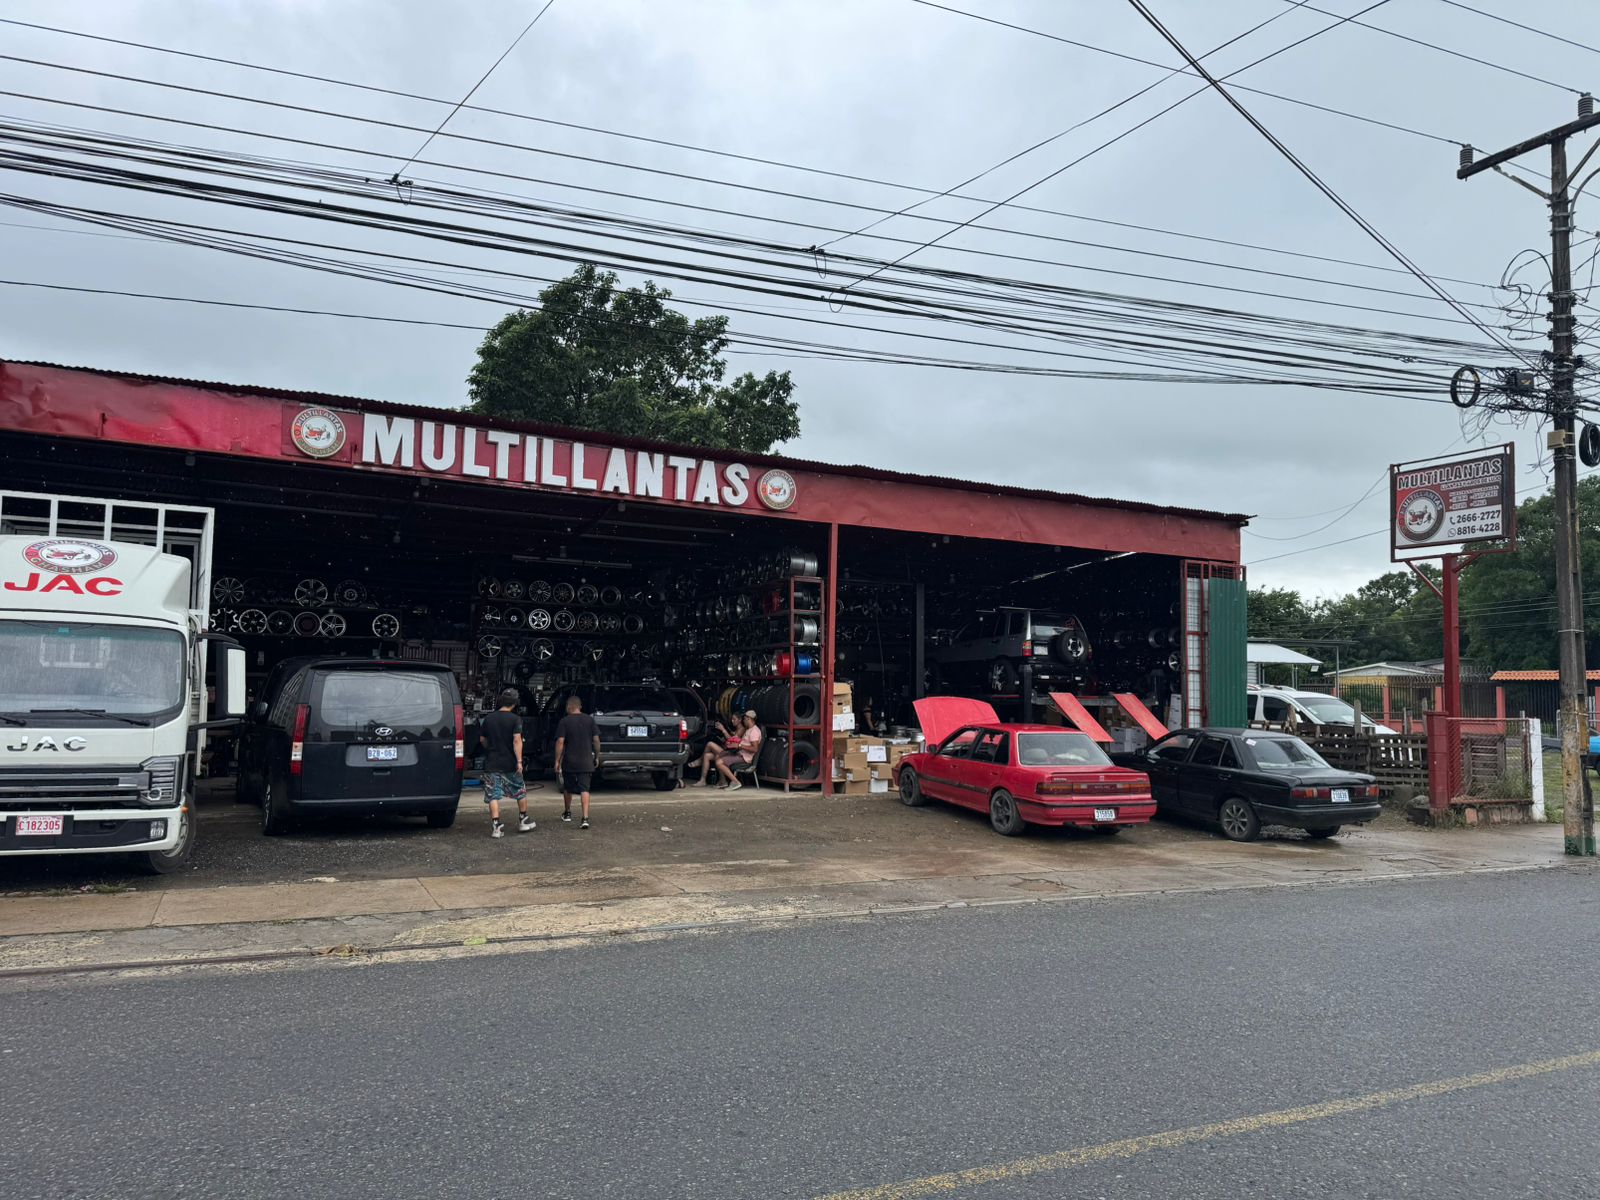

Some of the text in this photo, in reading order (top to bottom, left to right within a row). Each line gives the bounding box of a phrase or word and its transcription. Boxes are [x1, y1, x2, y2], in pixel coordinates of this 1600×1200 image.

[362, 413, 750, 506] MULTILLANTAS
[1397, 458, 1502, 491] MULTILLANTAS
[1456, 510, 1501, 524] 2666-2727
[1456, 522, 1501, 536] 8816-4228
[4, 572, 124, 596] JAC
[7, 736, 87, 752] JAC
[19, 821, 61, 831] C182305
